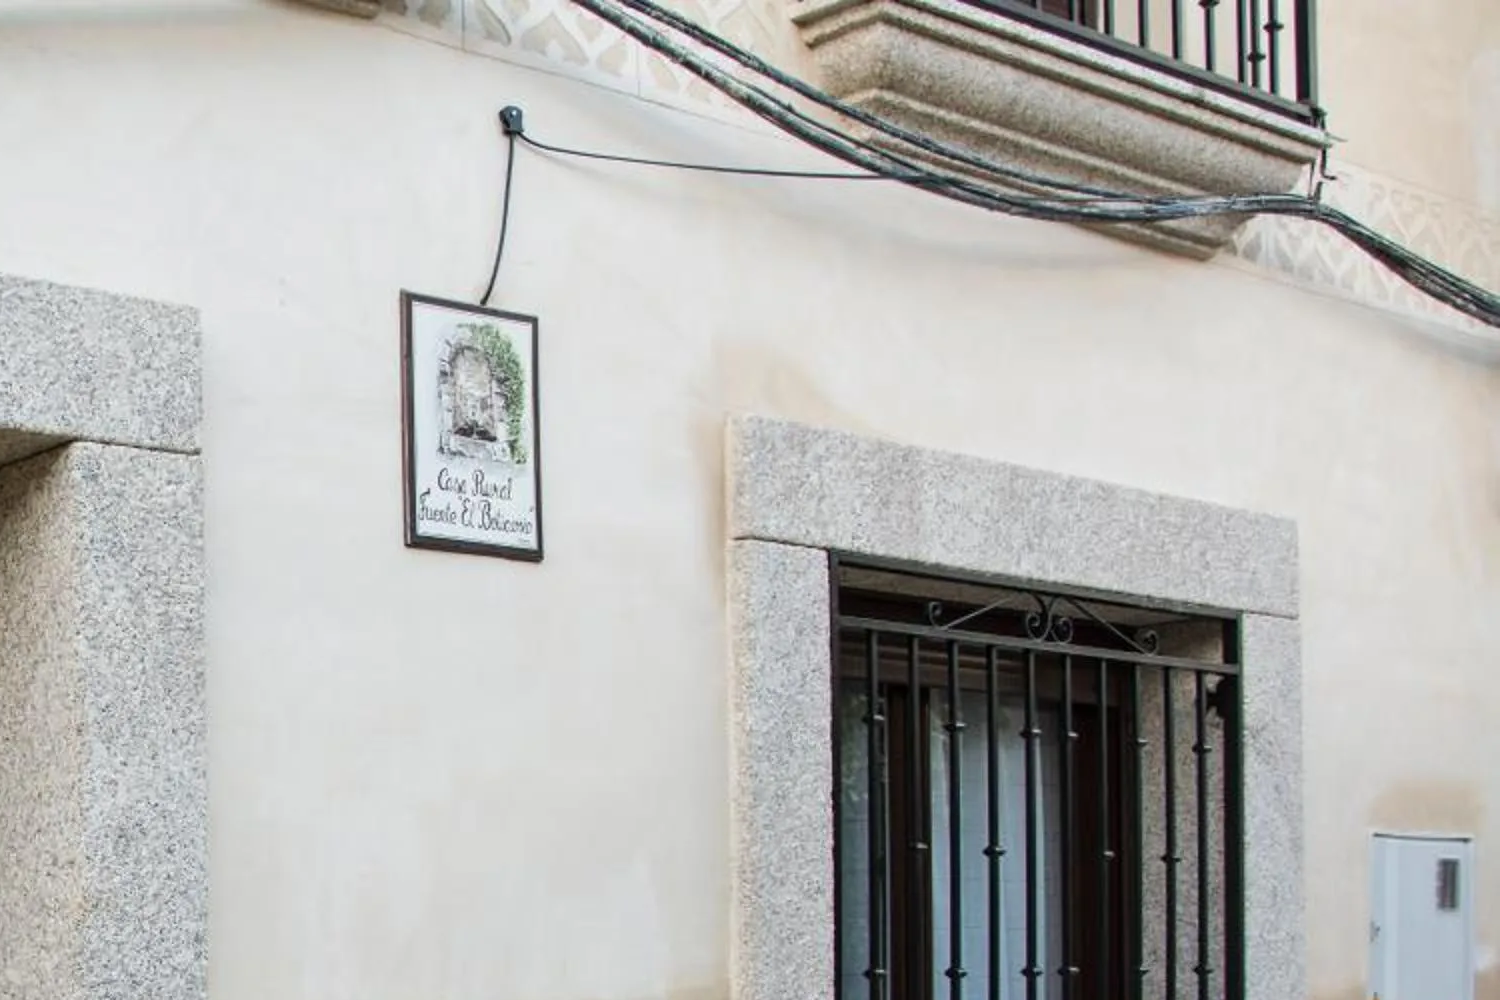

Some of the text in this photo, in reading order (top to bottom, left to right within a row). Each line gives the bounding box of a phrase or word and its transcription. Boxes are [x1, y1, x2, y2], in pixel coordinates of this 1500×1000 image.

[437, 467, 512, 501] Casa Rural
[418, 488, 457, 525] Fuente
